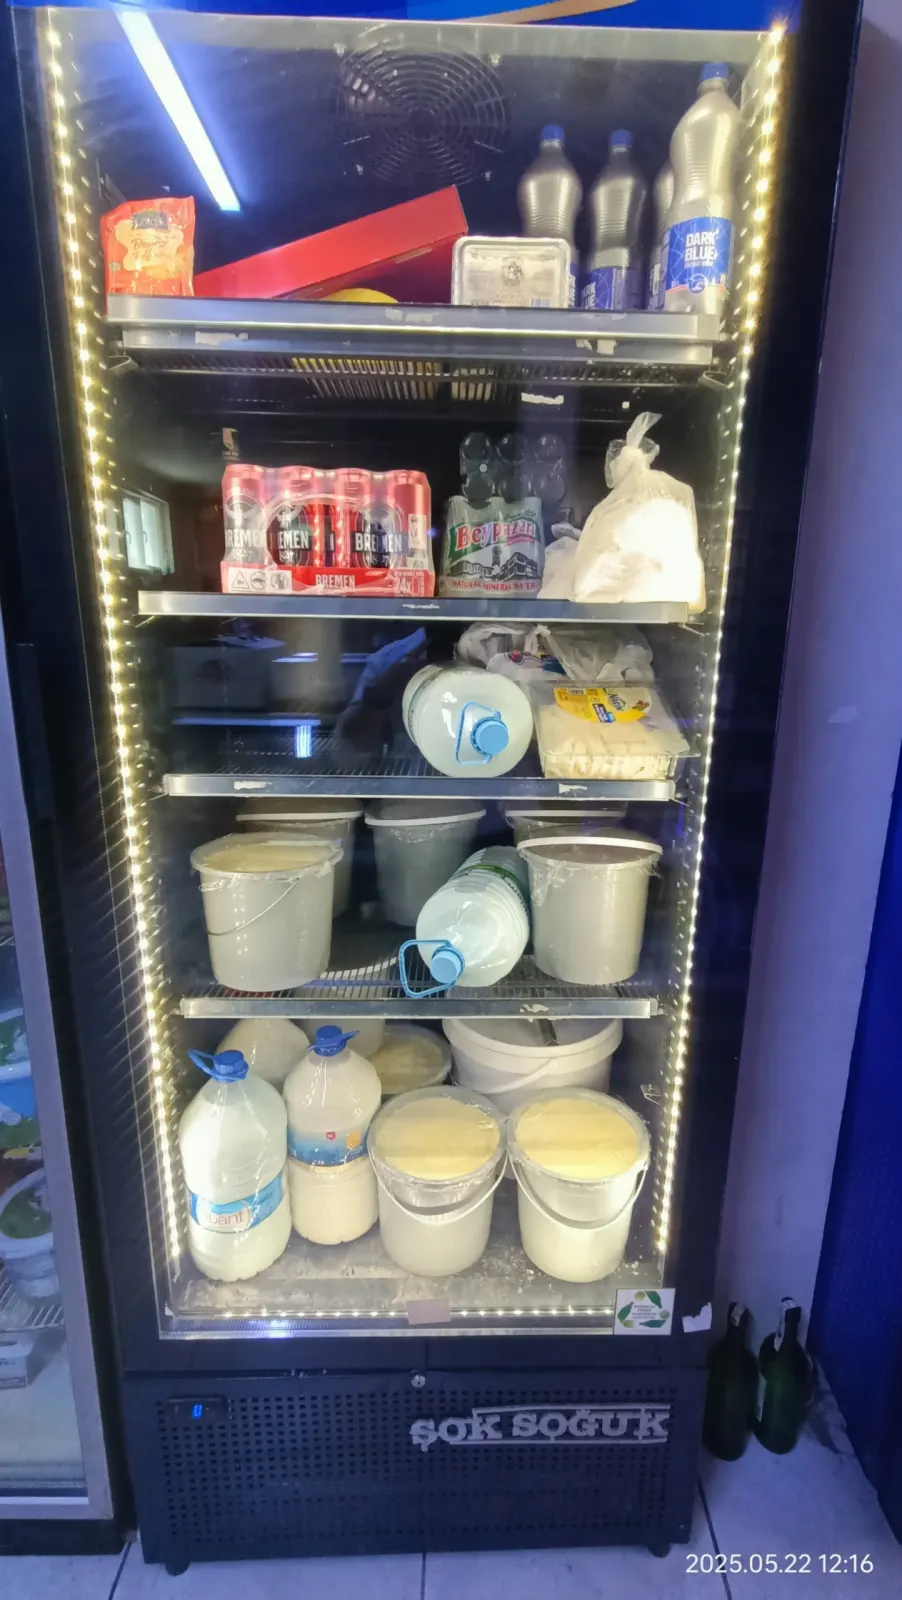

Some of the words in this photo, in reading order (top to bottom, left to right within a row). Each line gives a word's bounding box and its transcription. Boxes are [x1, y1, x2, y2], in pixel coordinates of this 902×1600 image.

[686, 232, 717, 248] DARK
[685, 246, 718, 263] BLUE
[315, 574, 355, 591] BREMEN
[452, 579, 481, 588] NATURAL
[483, 582, 512, 591] MINERAL
[513, 581, 536, 590] WATER
[410, 1412, 502, 1452] ŞOK
